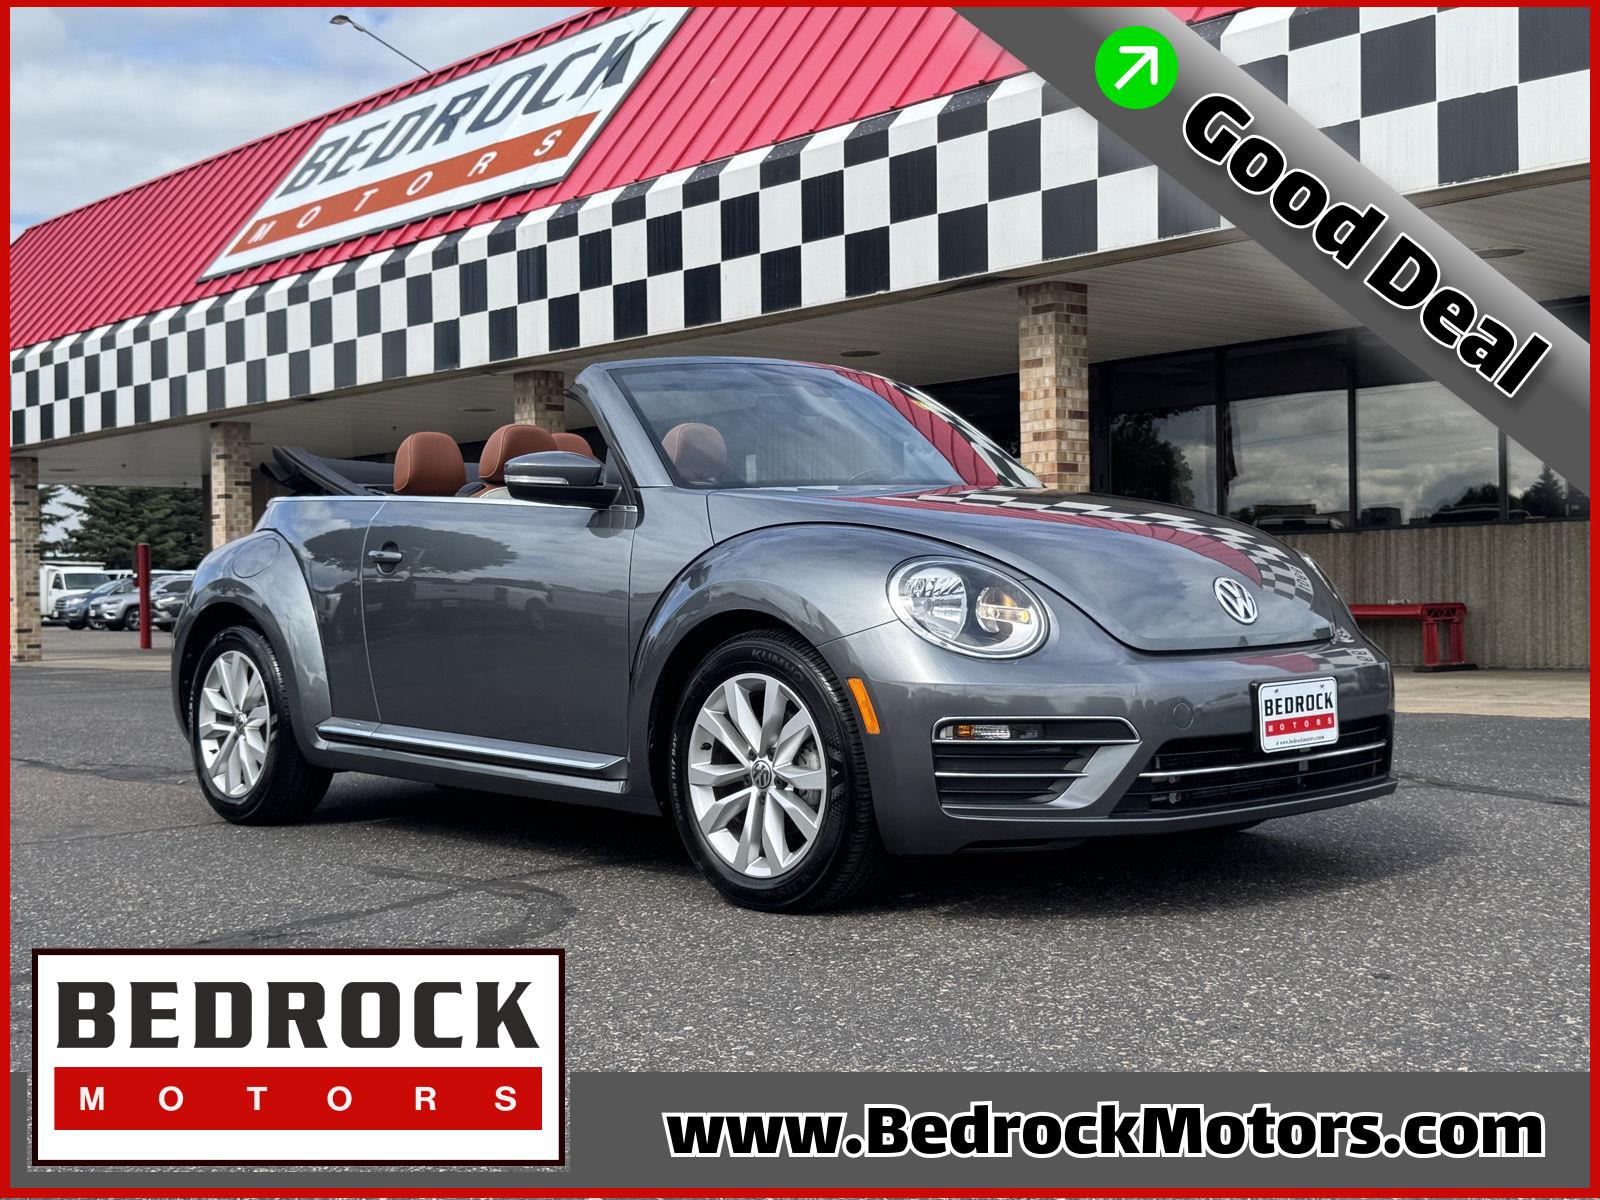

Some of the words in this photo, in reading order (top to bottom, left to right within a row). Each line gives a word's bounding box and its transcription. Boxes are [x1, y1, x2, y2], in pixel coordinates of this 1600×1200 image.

[279, 20, 664, 197] BEDROCK
[247, 129, 563, 244] MOTORS
[1264, 692, 1333, 716] BEDROCK
[1268, 717, 1332, 733] MOTORS
